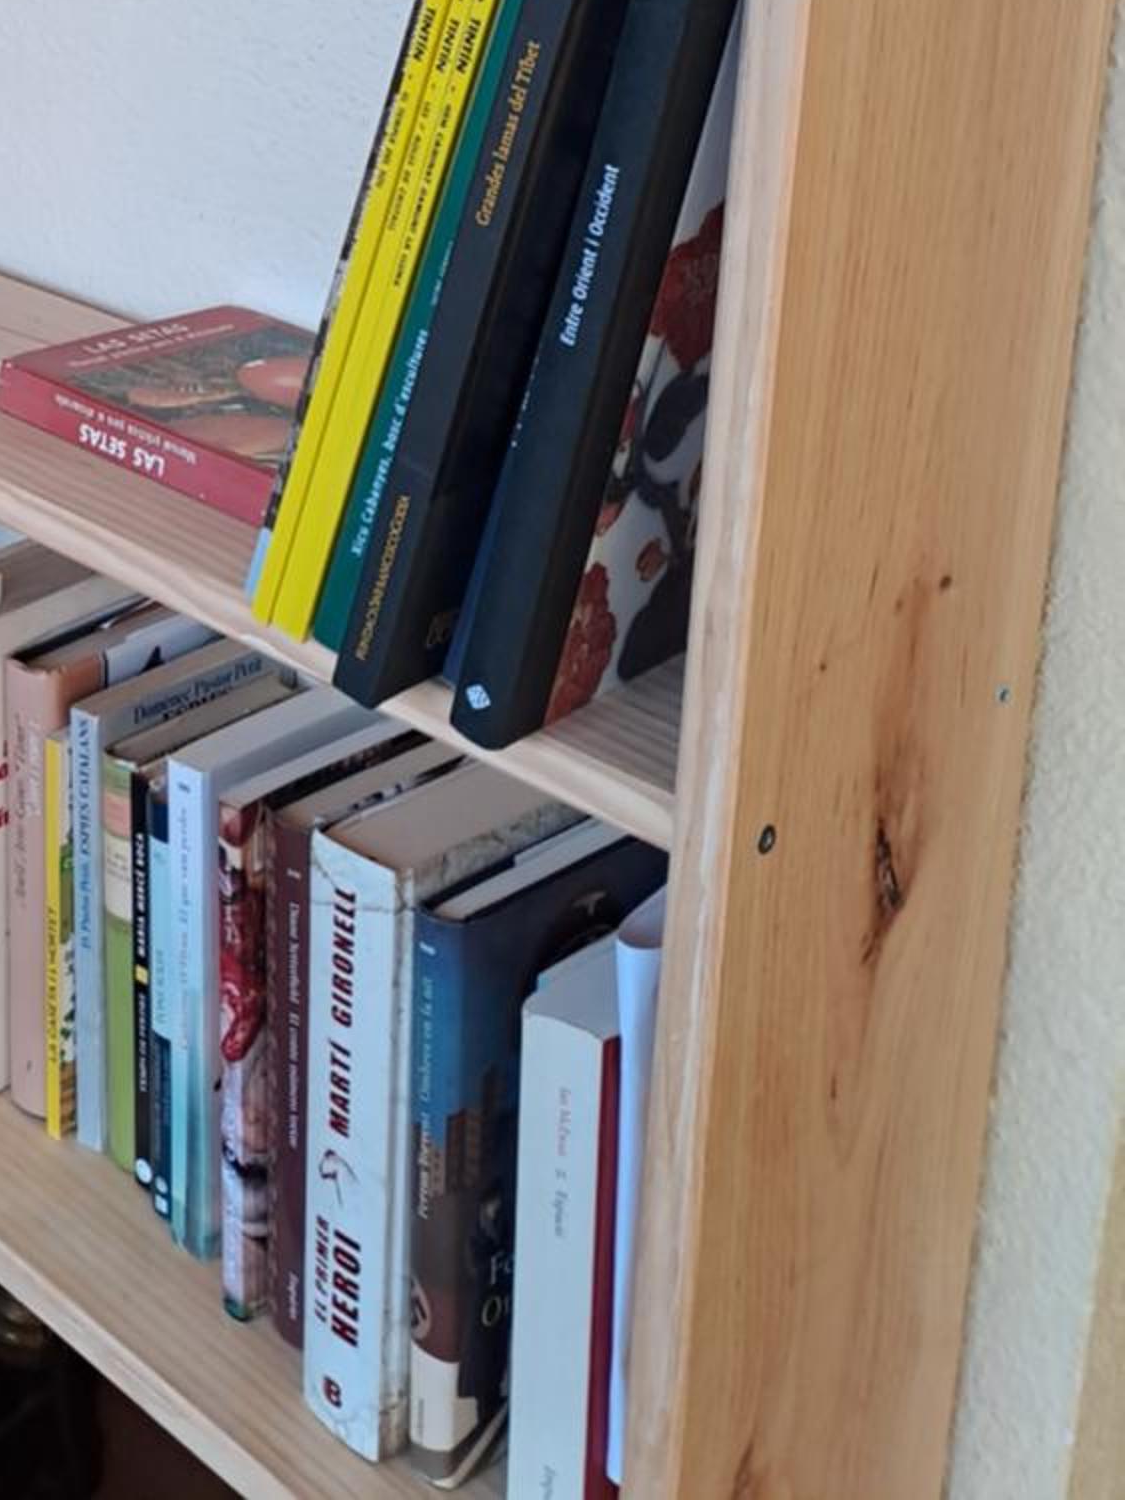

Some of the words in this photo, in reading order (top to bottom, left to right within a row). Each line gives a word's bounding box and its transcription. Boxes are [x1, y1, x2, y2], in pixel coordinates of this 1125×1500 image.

[475, 160, 506, 227] Grandes
[492, 114, 521, 164] lamas
[507, 82, 529, 114] del
[559, 302, 585, 347] Entre
[572, 250, 599, 301] Orient
[587, 163, 620, 238] Occident
[78, 423, 127, 461] SETAS
[132, 446, 165, 477] LAS
[75, 717, 91, 799] CATALANS
[76, 801, 92, 857] ESPIES
[134, 833, 146, 867] ROCA
[135, 917, 147, 958] MARIA
[330, 883, 357, 1030] GIRONELL
[324, 1036, 353, 1140] MARTÍ
[315, 1215, 329, 1300] PRIMER
[331, 1229, 362, 1348] HEROI
[314, 1303, 329, 1322] EL
